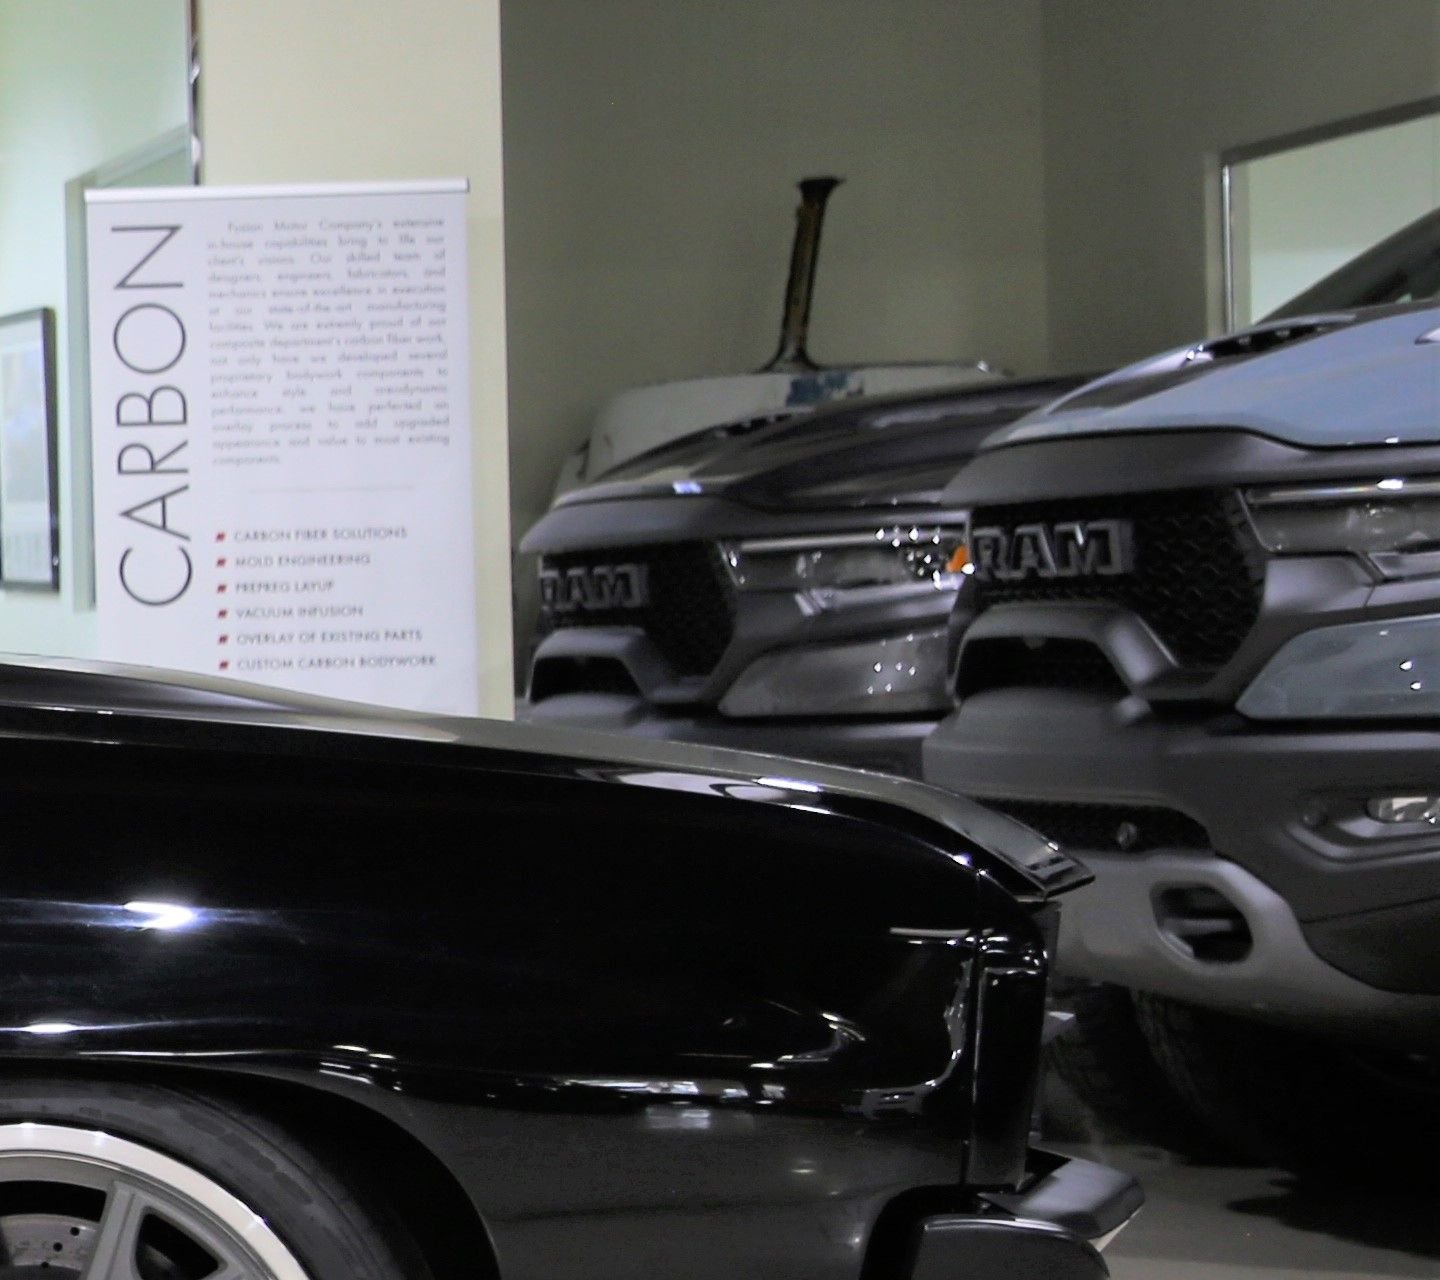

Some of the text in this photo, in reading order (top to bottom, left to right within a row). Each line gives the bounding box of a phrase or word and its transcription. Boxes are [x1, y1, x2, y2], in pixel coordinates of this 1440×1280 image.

[111, 225, 192, 606] CARBON
[234, 528, 408, 542] CARBON FIBER SOLUTIONS
[969, 520, 1132, 580] RAM
[236, 553, 370, 567] MOLD ENGINEERING
[236, 581, 334, 593] PREPREG LAYUP
[541, 564, 648, 613] RAM
[236, 606, 364, 619] VACUUM INFUSION
[237, 629, 422, 645] OVERLAY OF EXISTING PARTS
[237, 656, 436, 671] CUSTOM CARBON BODYWORK
